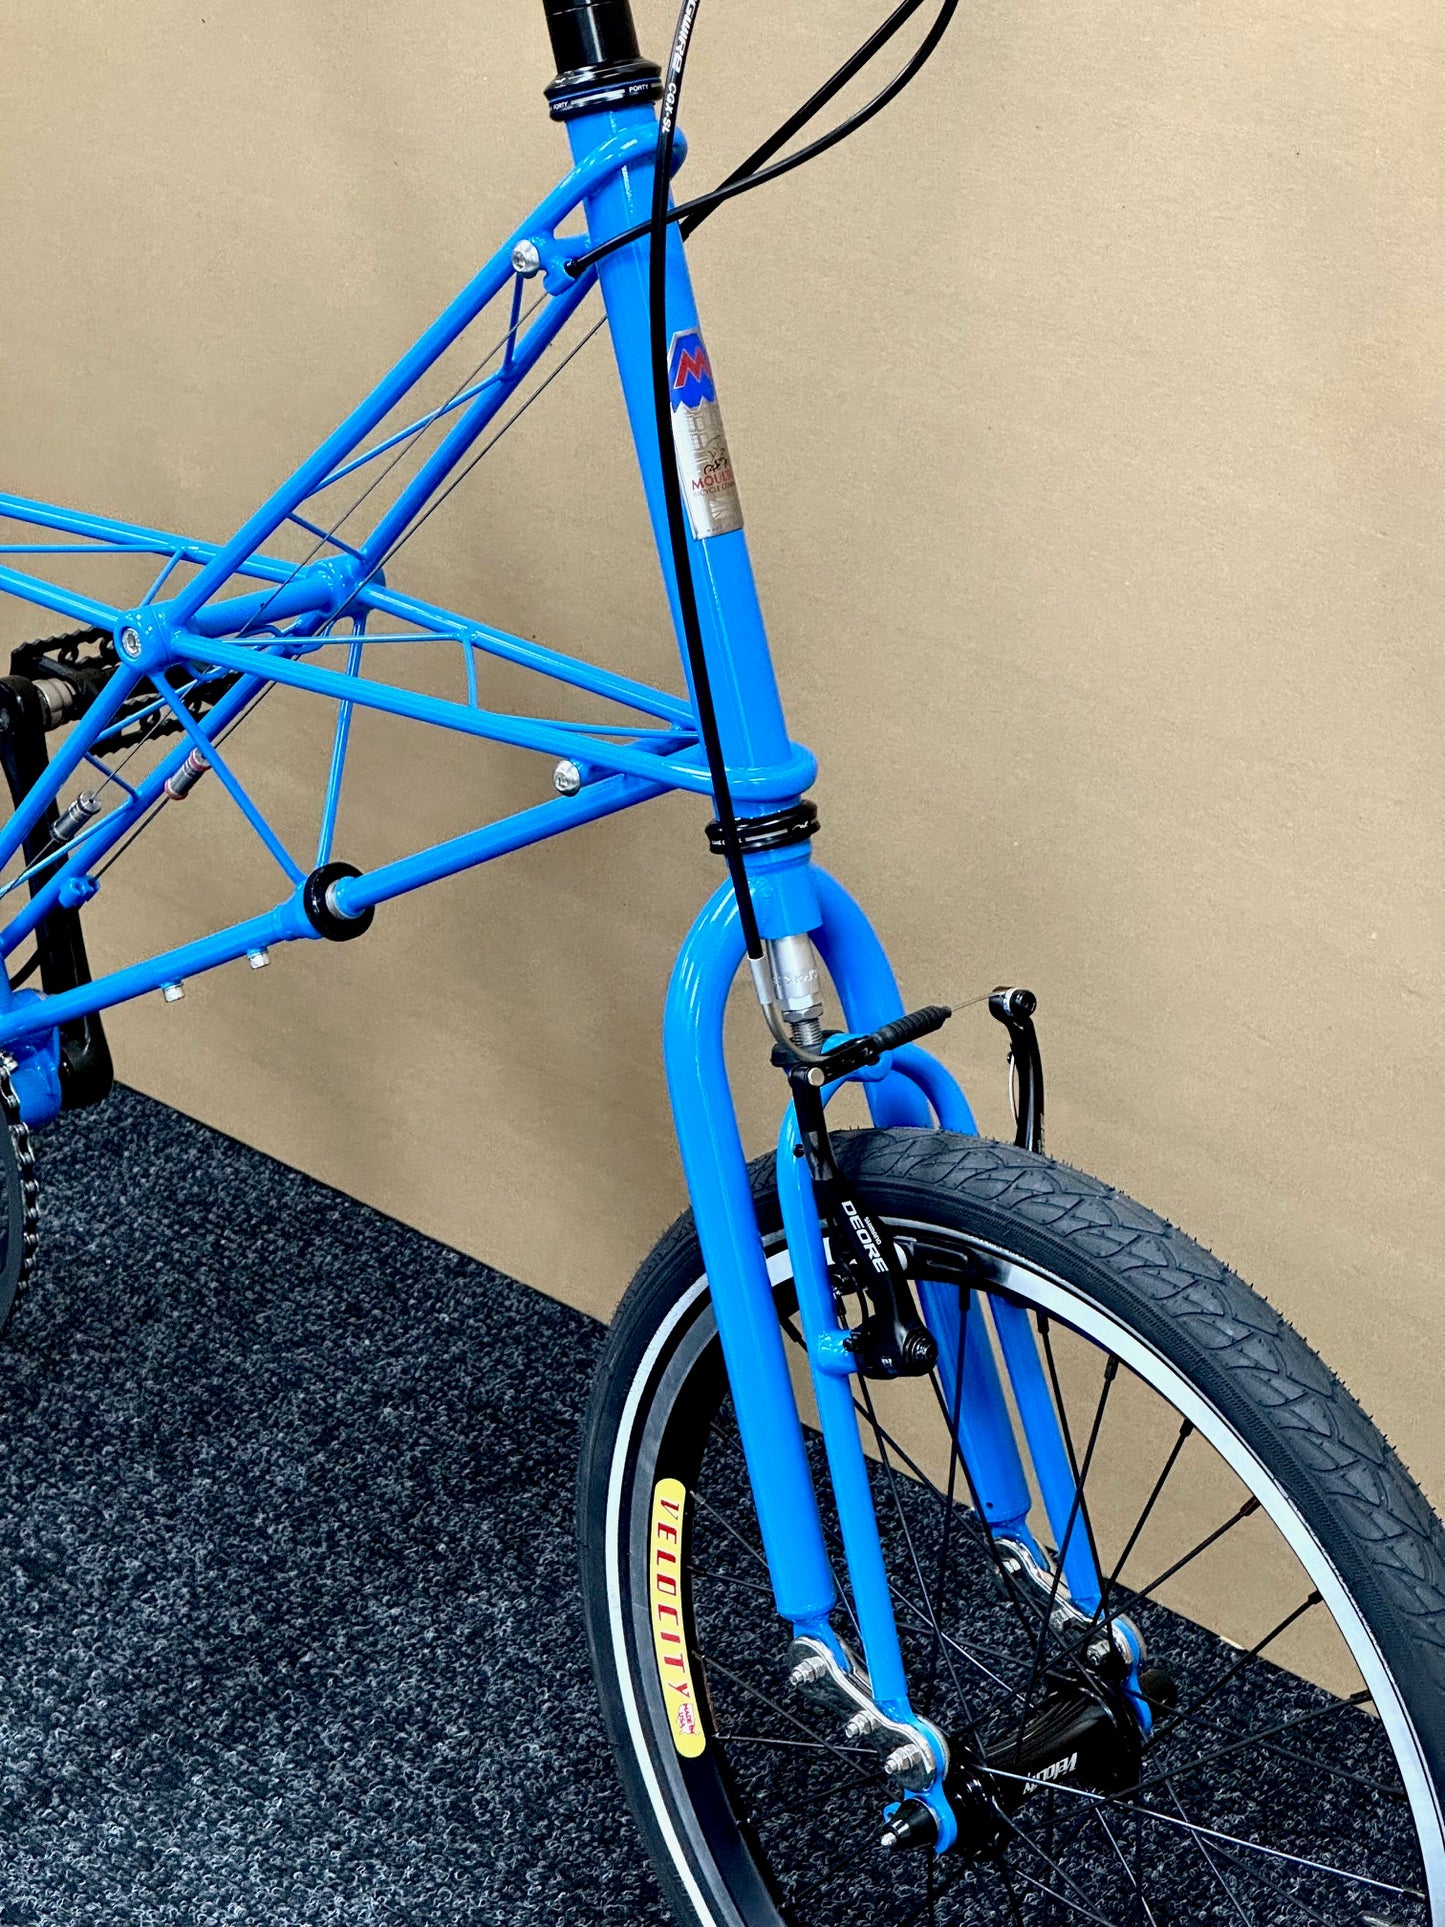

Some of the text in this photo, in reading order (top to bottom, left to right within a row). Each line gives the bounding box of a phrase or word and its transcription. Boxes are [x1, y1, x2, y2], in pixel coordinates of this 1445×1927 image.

[662, 0, 697, 133] GWIRE CGX-SL
[629, 84, 649, 93] FORTY
[553, 101, 568, 110] FORTY
[841, 1200, 889, 1273] DEORE
[656, 1499, 690, 1698] VELOCITY
[678, 1712, 686, 1728] USA
[682, 1703, 692, 1724] MADE
